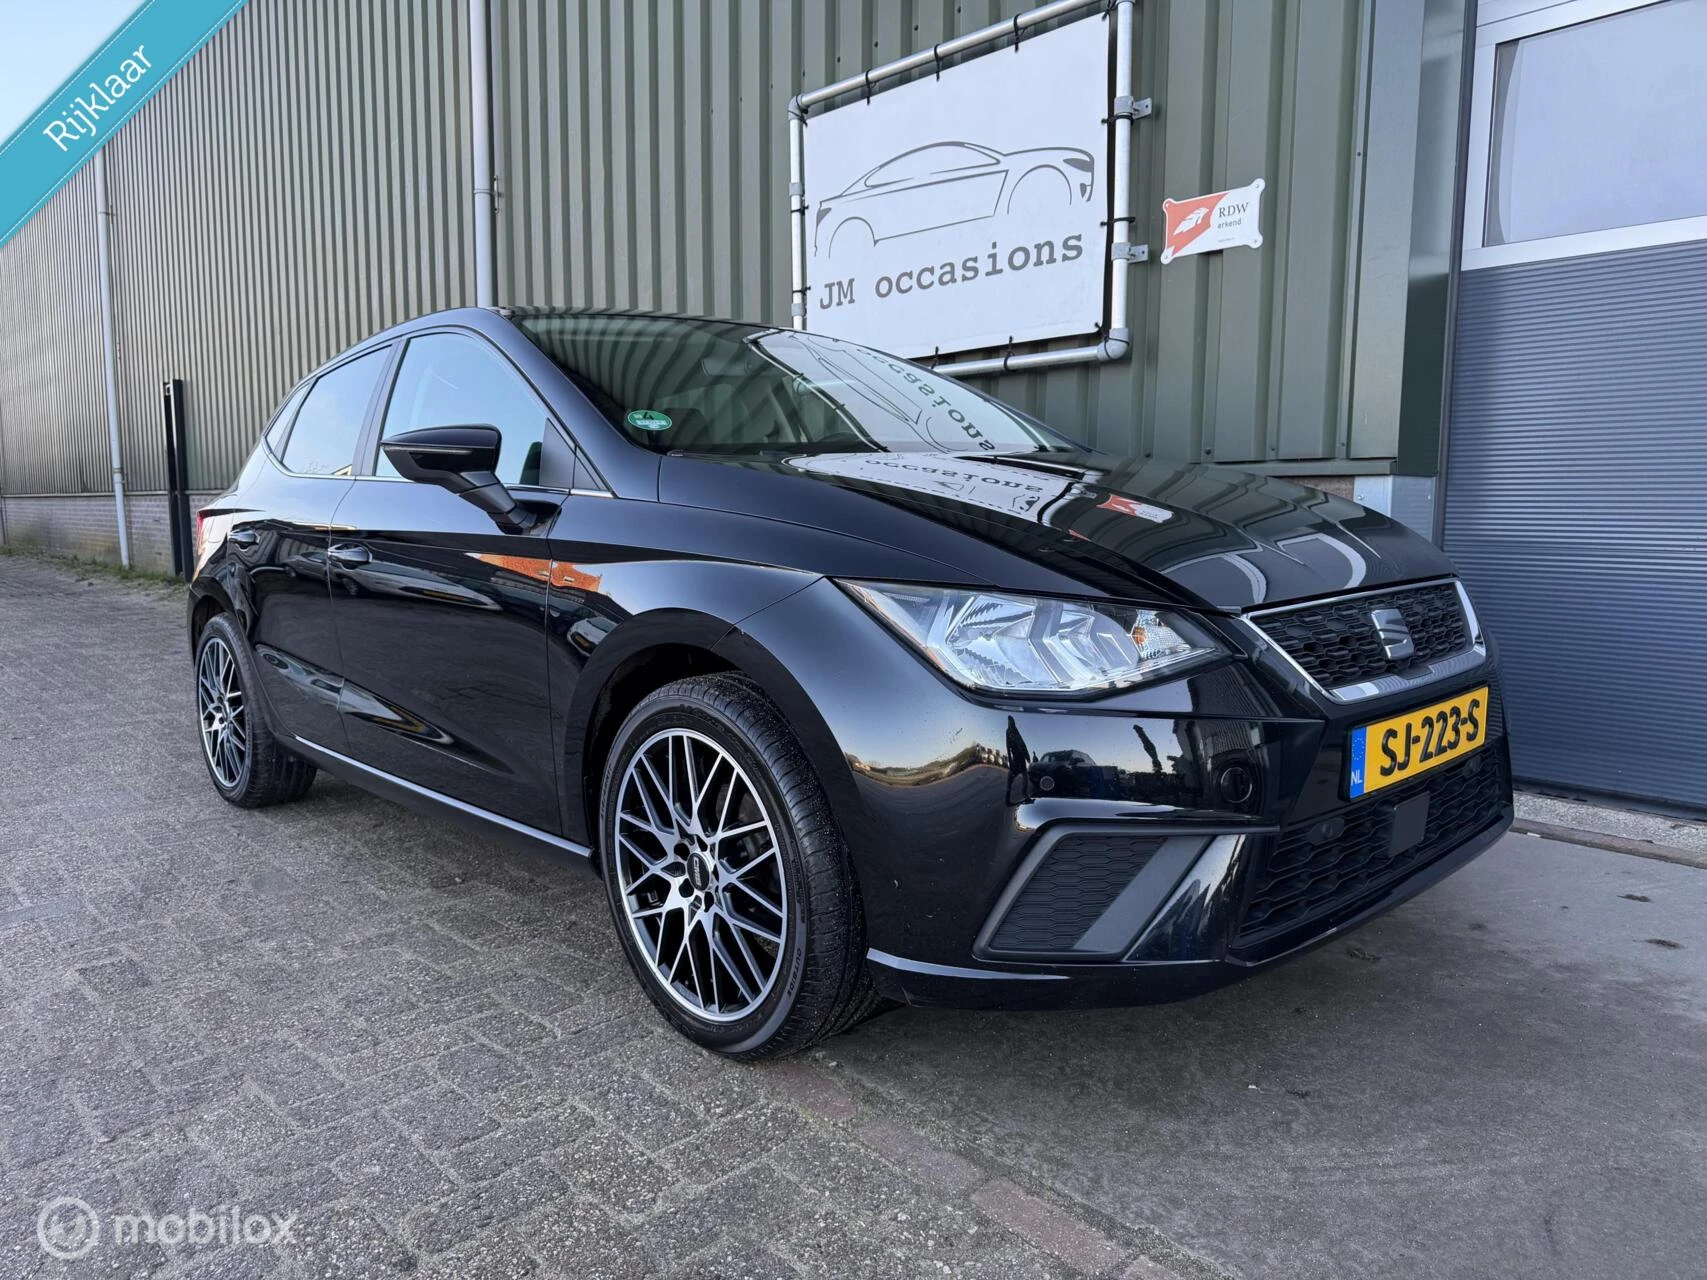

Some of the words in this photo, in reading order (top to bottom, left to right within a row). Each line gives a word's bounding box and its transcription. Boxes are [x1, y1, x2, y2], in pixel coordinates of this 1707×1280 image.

[1218, 202, 1249, 218] RDW
[1217, 218, 1242, 229] erkend
[819, 278, 856, 310] JM
[874, 233, 1084, 299] occasions
[1379, 698, 1480, 777] SJ-223-S
[1350, 769, 1363, 787] NL
